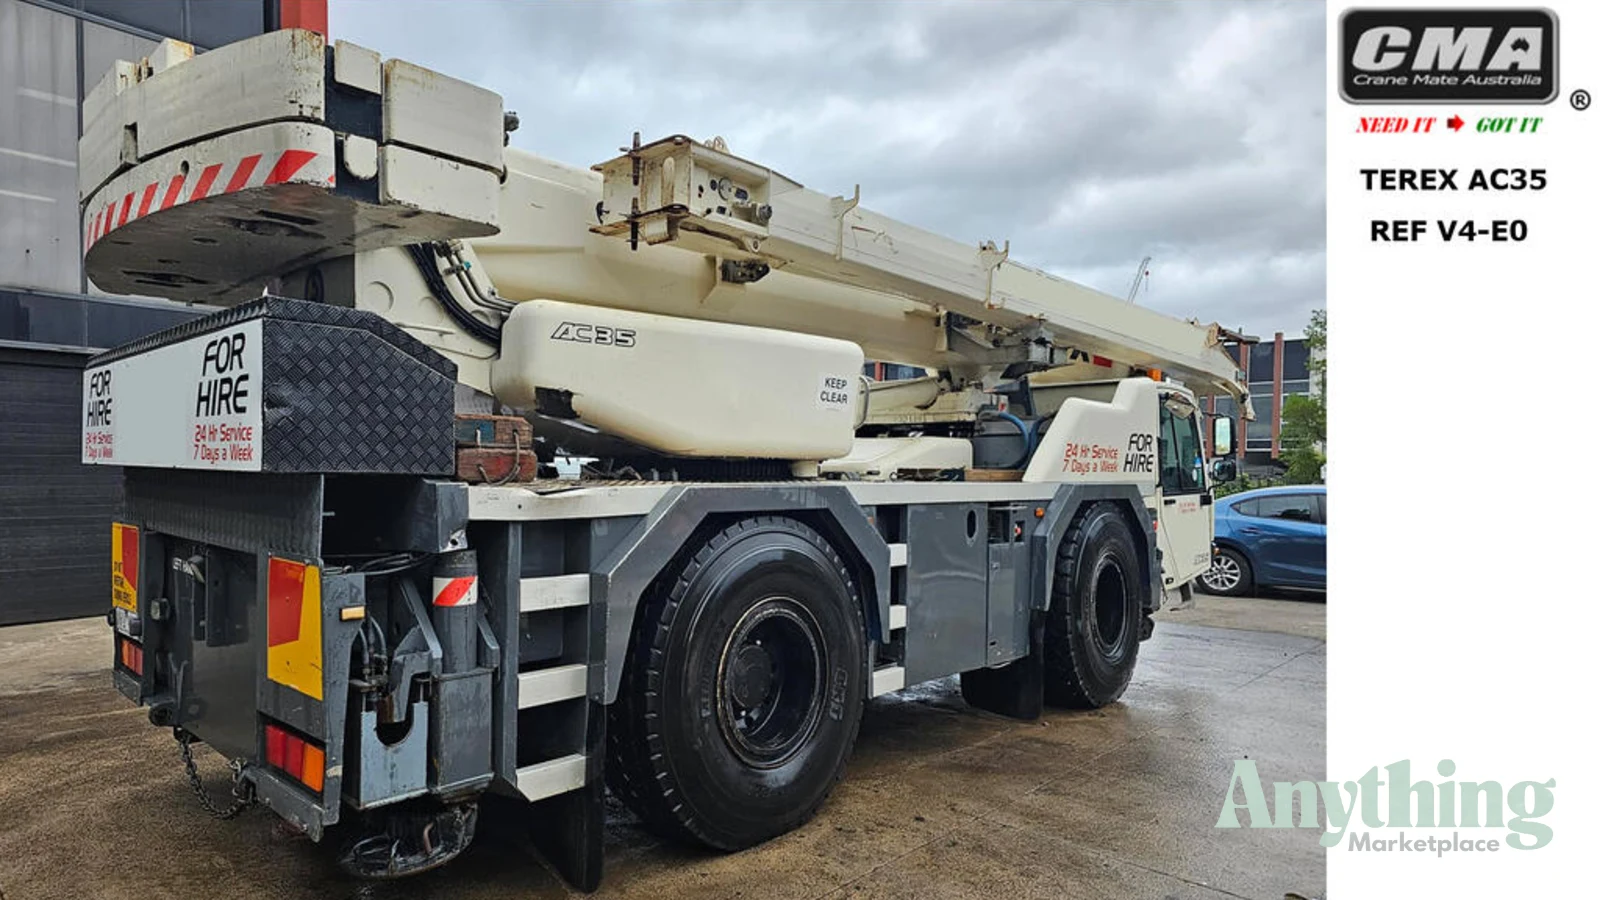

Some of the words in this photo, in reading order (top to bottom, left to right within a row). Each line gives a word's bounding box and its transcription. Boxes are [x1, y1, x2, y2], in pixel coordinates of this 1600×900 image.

[550, 321, 637, 348] AC35
[202, 332, 246, 377] FOR
[90, 369, 112, 399] FOR
[825, 377, 847, 389] KEEP
[196, 373, 249, 418] HIRE
[820, 390, 847, 404] CLEAR
[86, 398, 112, 427] HIRE
[194, 424, 206, 442] 24
[208, 424, 217, 442] Hr
[219, 422, 253, 442] Service
[1065, 442, 1079, 458] 24
[1091, 444, 1119, 459] Service
[1127, 433, 1153, 453] FOR
[193, 444, 200, 460] 7
[201, 444, 220, 464] Days
[221, 447, 227, 460] a
[229, 444, 253, 461] Week
[1122, 453, 1154, 473] HIRE
[1062, 459, 1069, 472] 7
[1071, 459, 1090, 475] Days
[1092, 462, 1097, 472] a
[1099, 460, 1118, 473] Week
